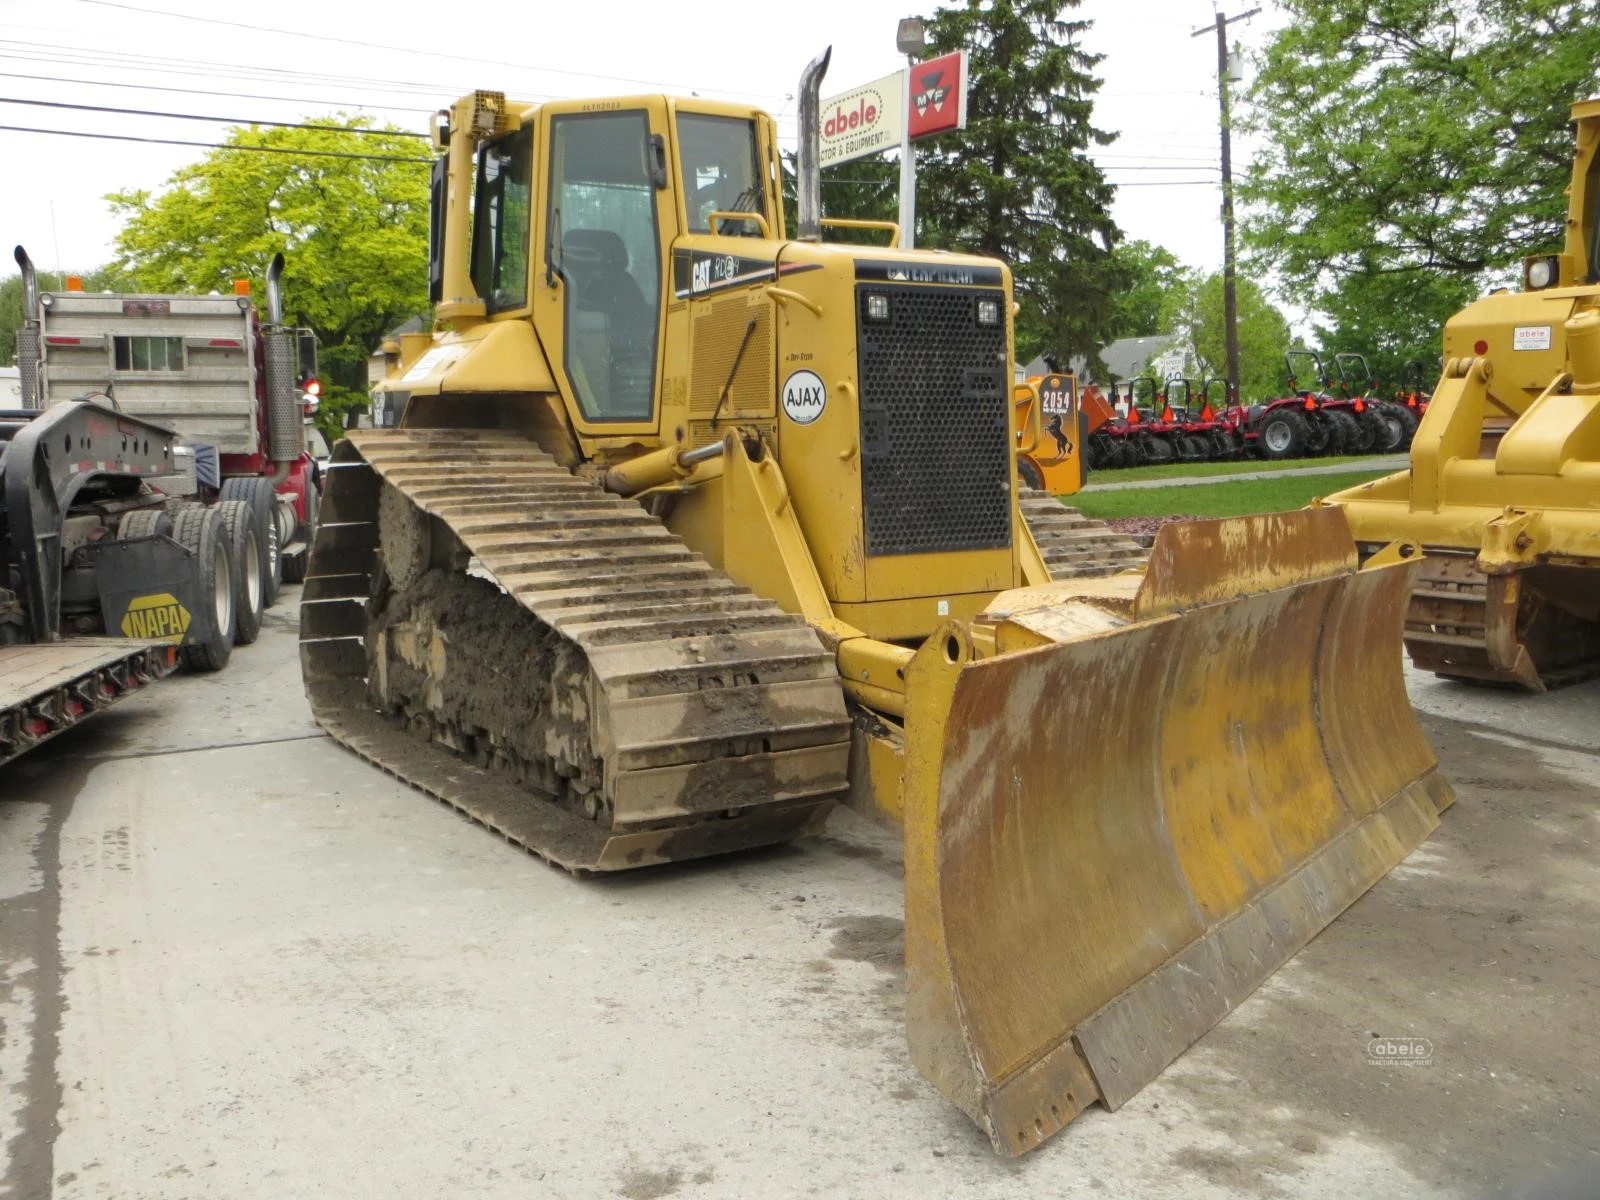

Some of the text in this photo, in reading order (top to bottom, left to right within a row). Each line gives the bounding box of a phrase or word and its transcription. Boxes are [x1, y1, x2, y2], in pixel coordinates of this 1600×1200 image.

[824, 98, 877, 137] abele
[820, 146, 836, 161] CTOR
[839, 144, 843, 156] &
[846, 131, 884, 154] EQUIPMENT
[692, 259, 711, 293] CAT
[786, 387, 822, 407] AJAX
[1043, 391, 1070, 409] 2054
[129, 605, 183, 638] NAPA
